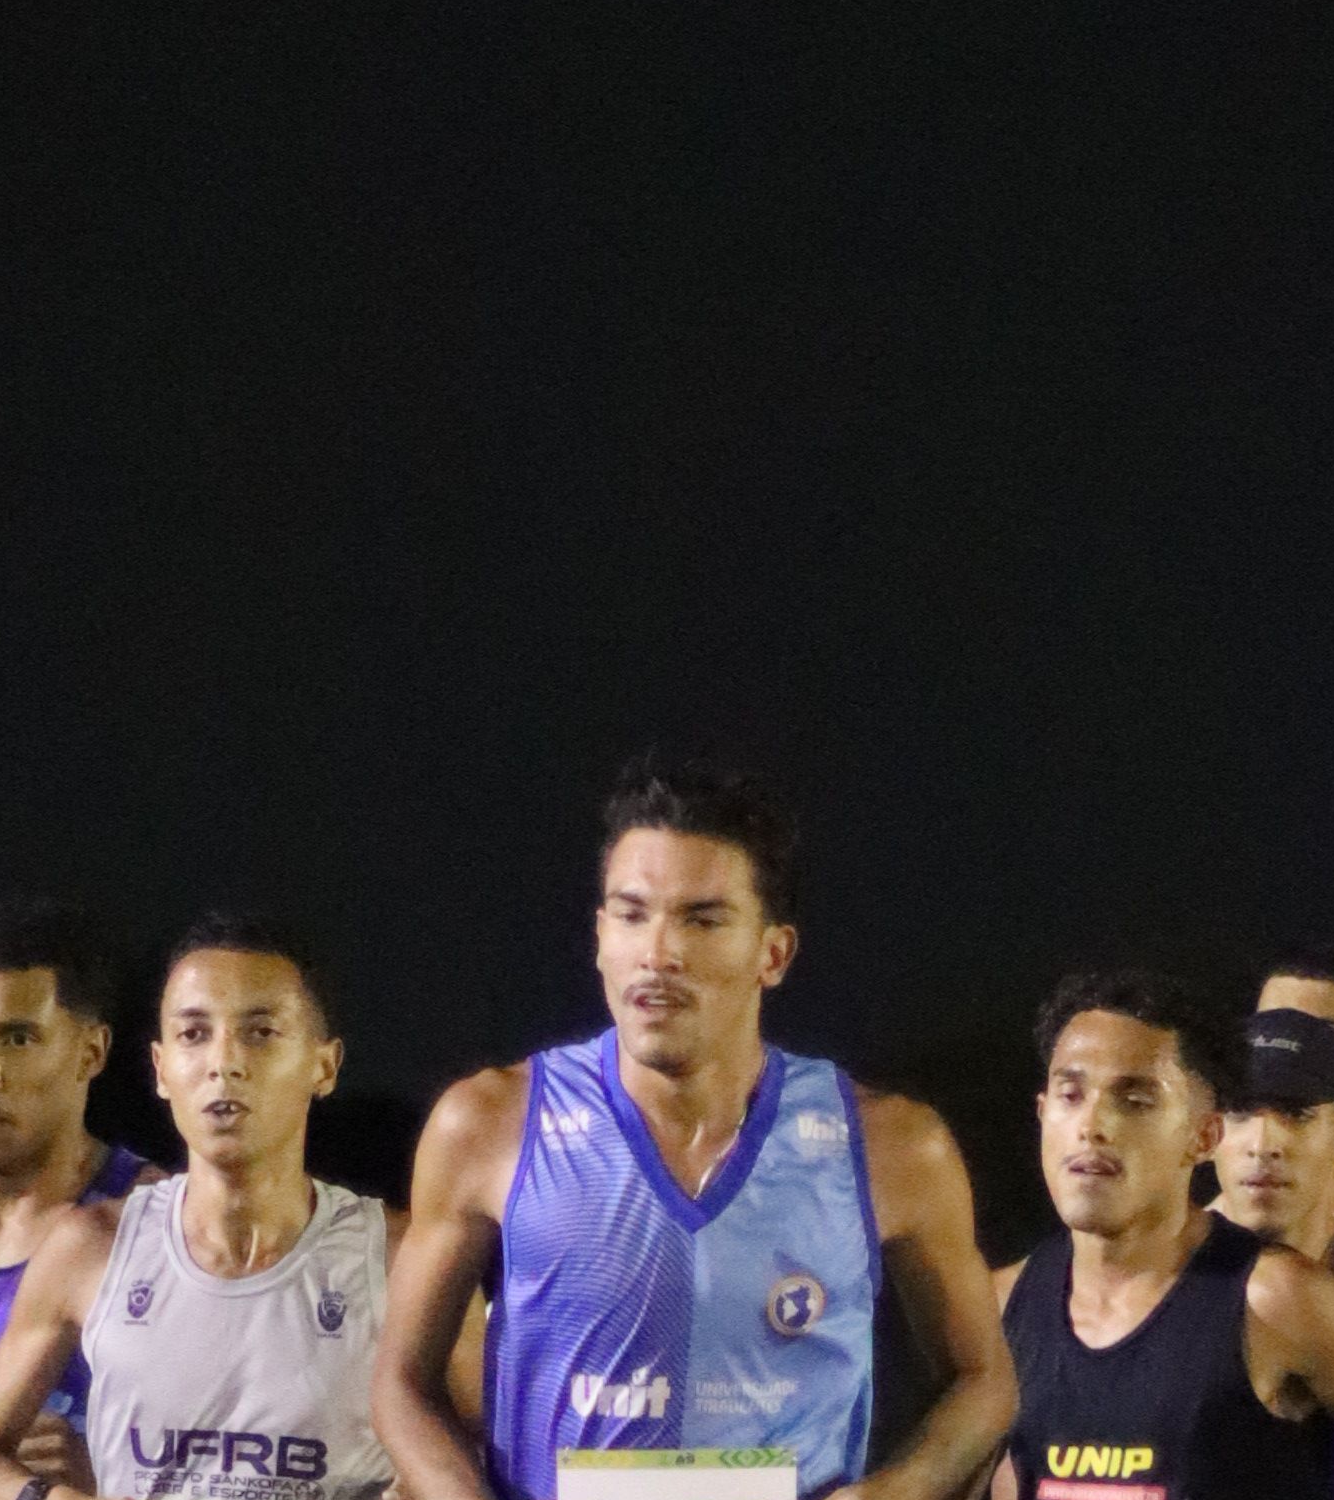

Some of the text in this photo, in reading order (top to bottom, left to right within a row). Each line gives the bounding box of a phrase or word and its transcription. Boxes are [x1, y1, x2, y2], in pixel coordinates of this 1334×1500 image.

[571, 1367, 671, 1418] Unit
[130, 1427, 328, 1481] UFRB
[1047, 1445, 1153, 1478] UNIP
